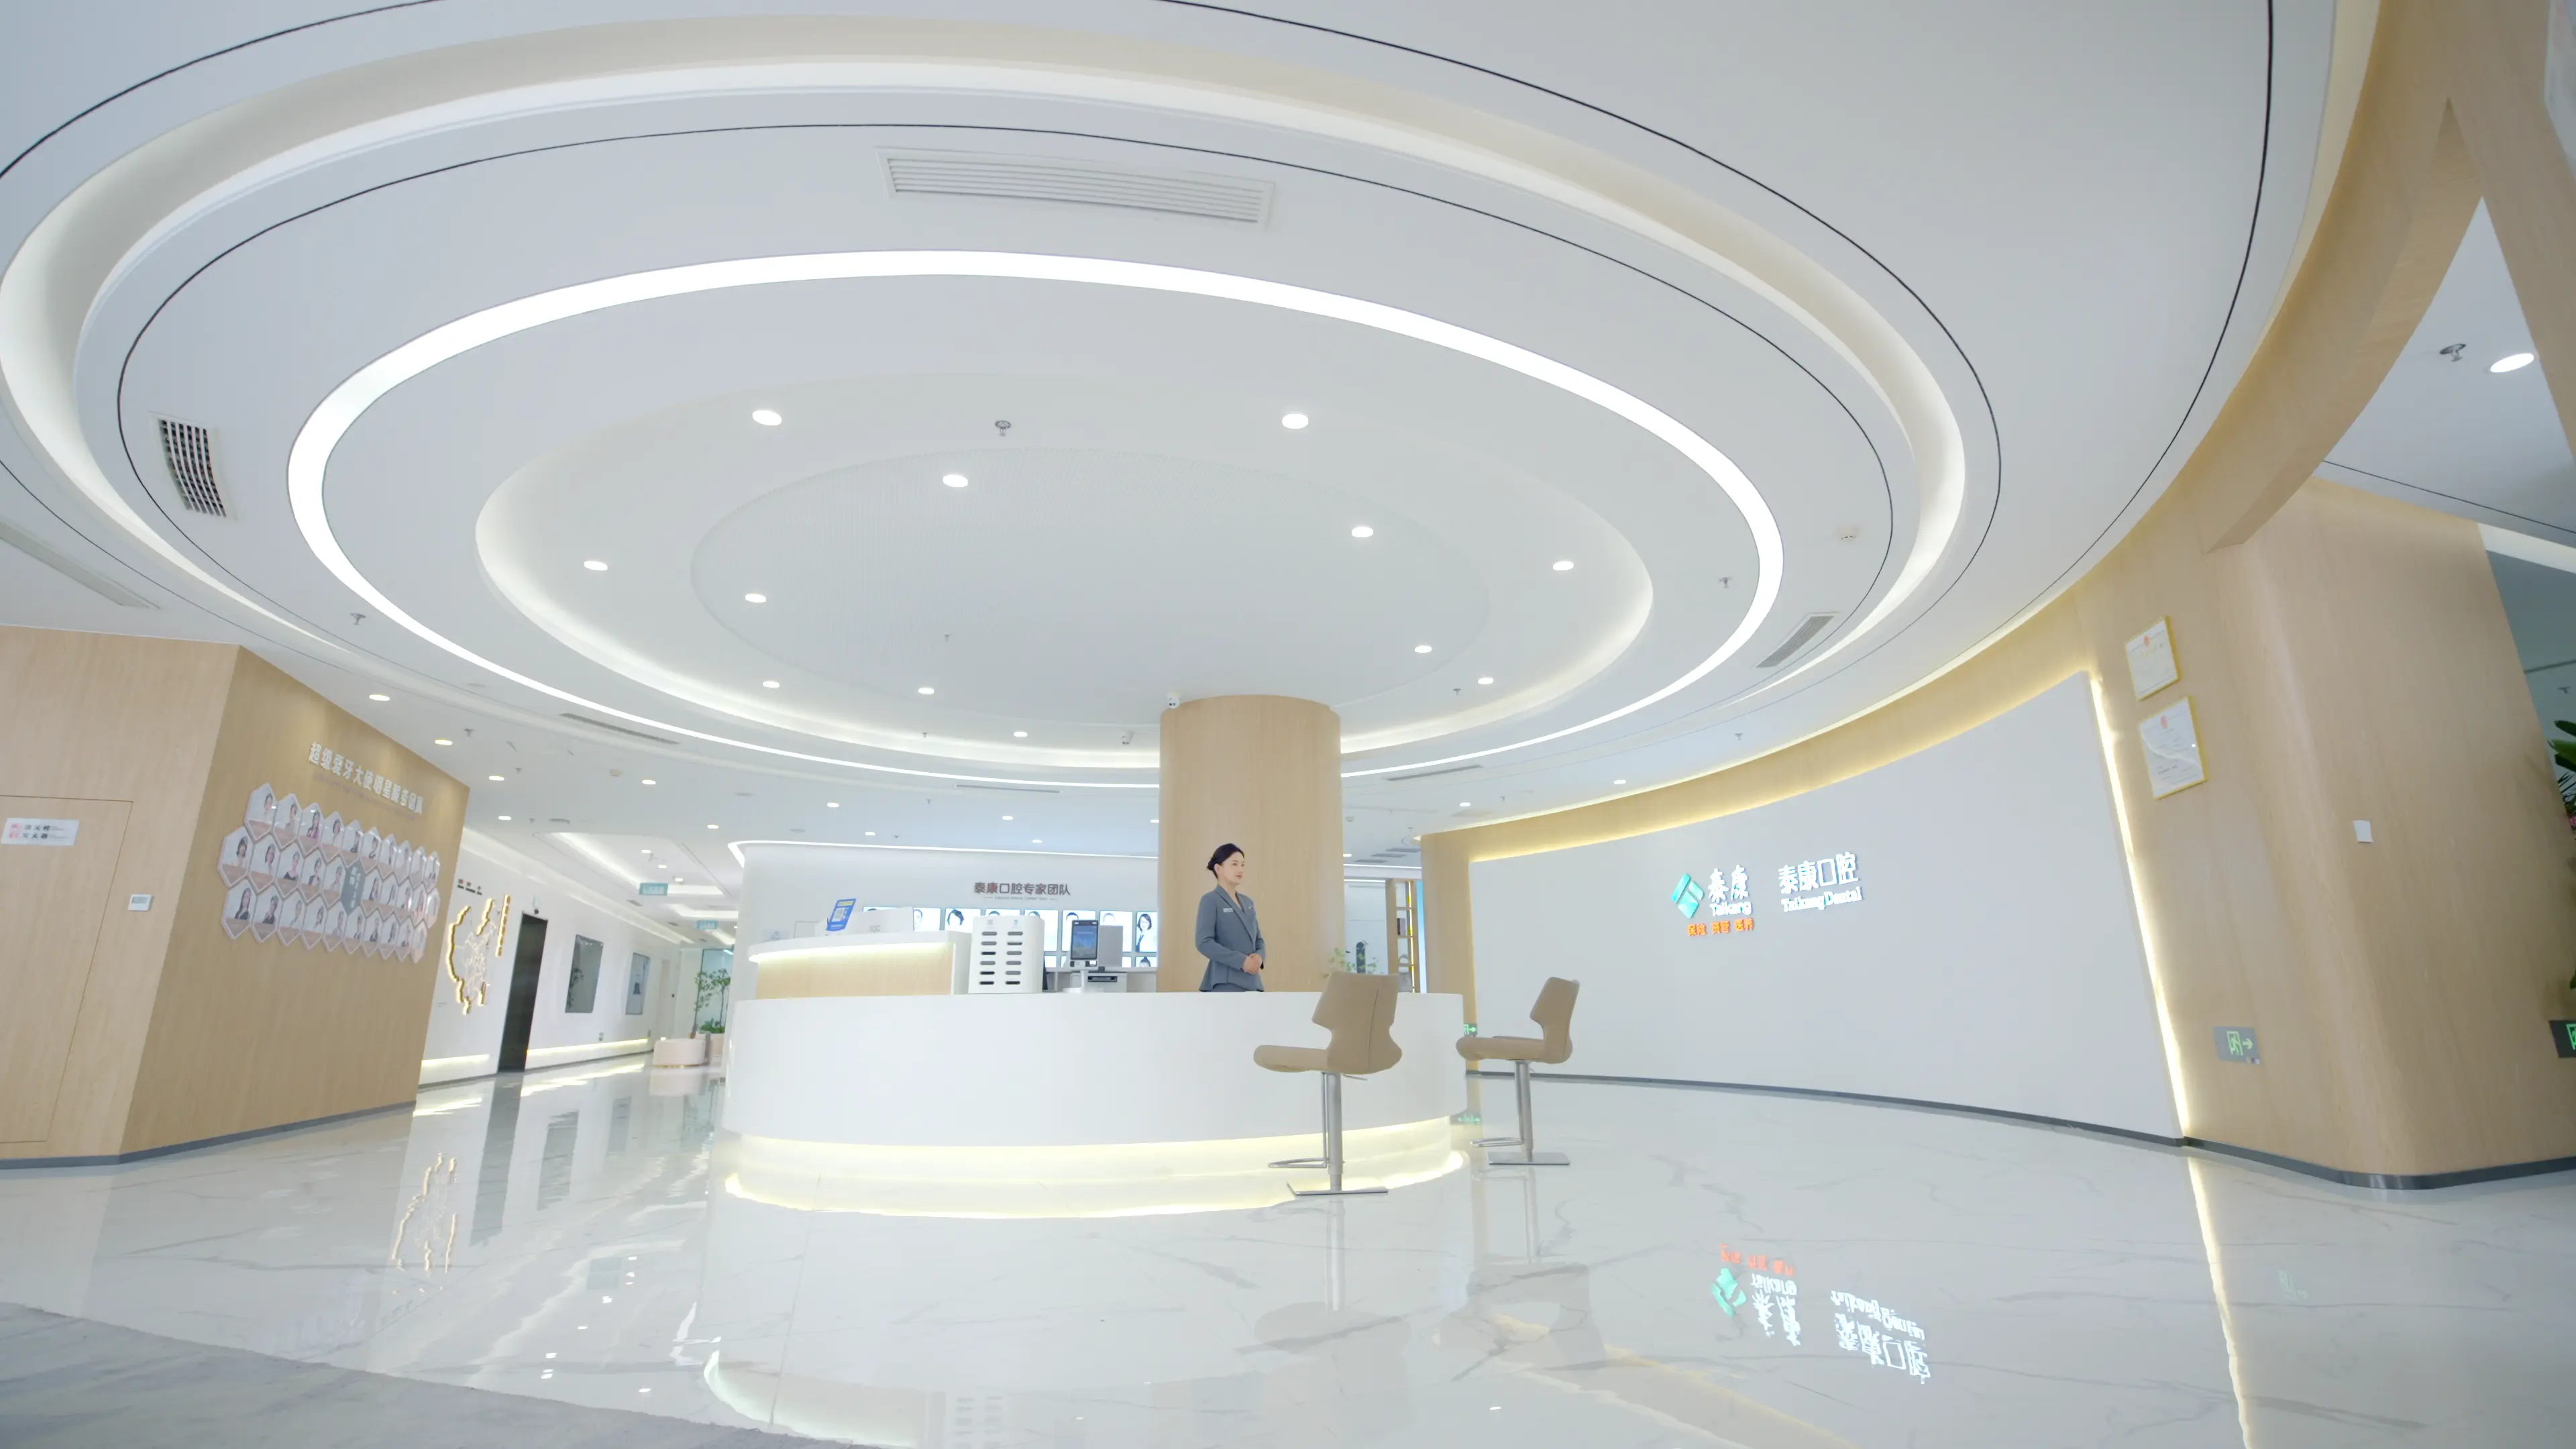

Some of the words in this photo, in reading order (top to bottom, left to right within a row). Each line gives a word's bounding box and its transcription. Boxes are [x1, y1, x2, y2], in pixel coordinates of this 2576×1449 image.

[1708, 865, 1749, 903] 泰康
[1778, 851, 1859, 894] 泰康口腔
[974, 881, 1071, 896] 泰康口腔专家团队
[1710, 902, 1752, 917] Taikang
